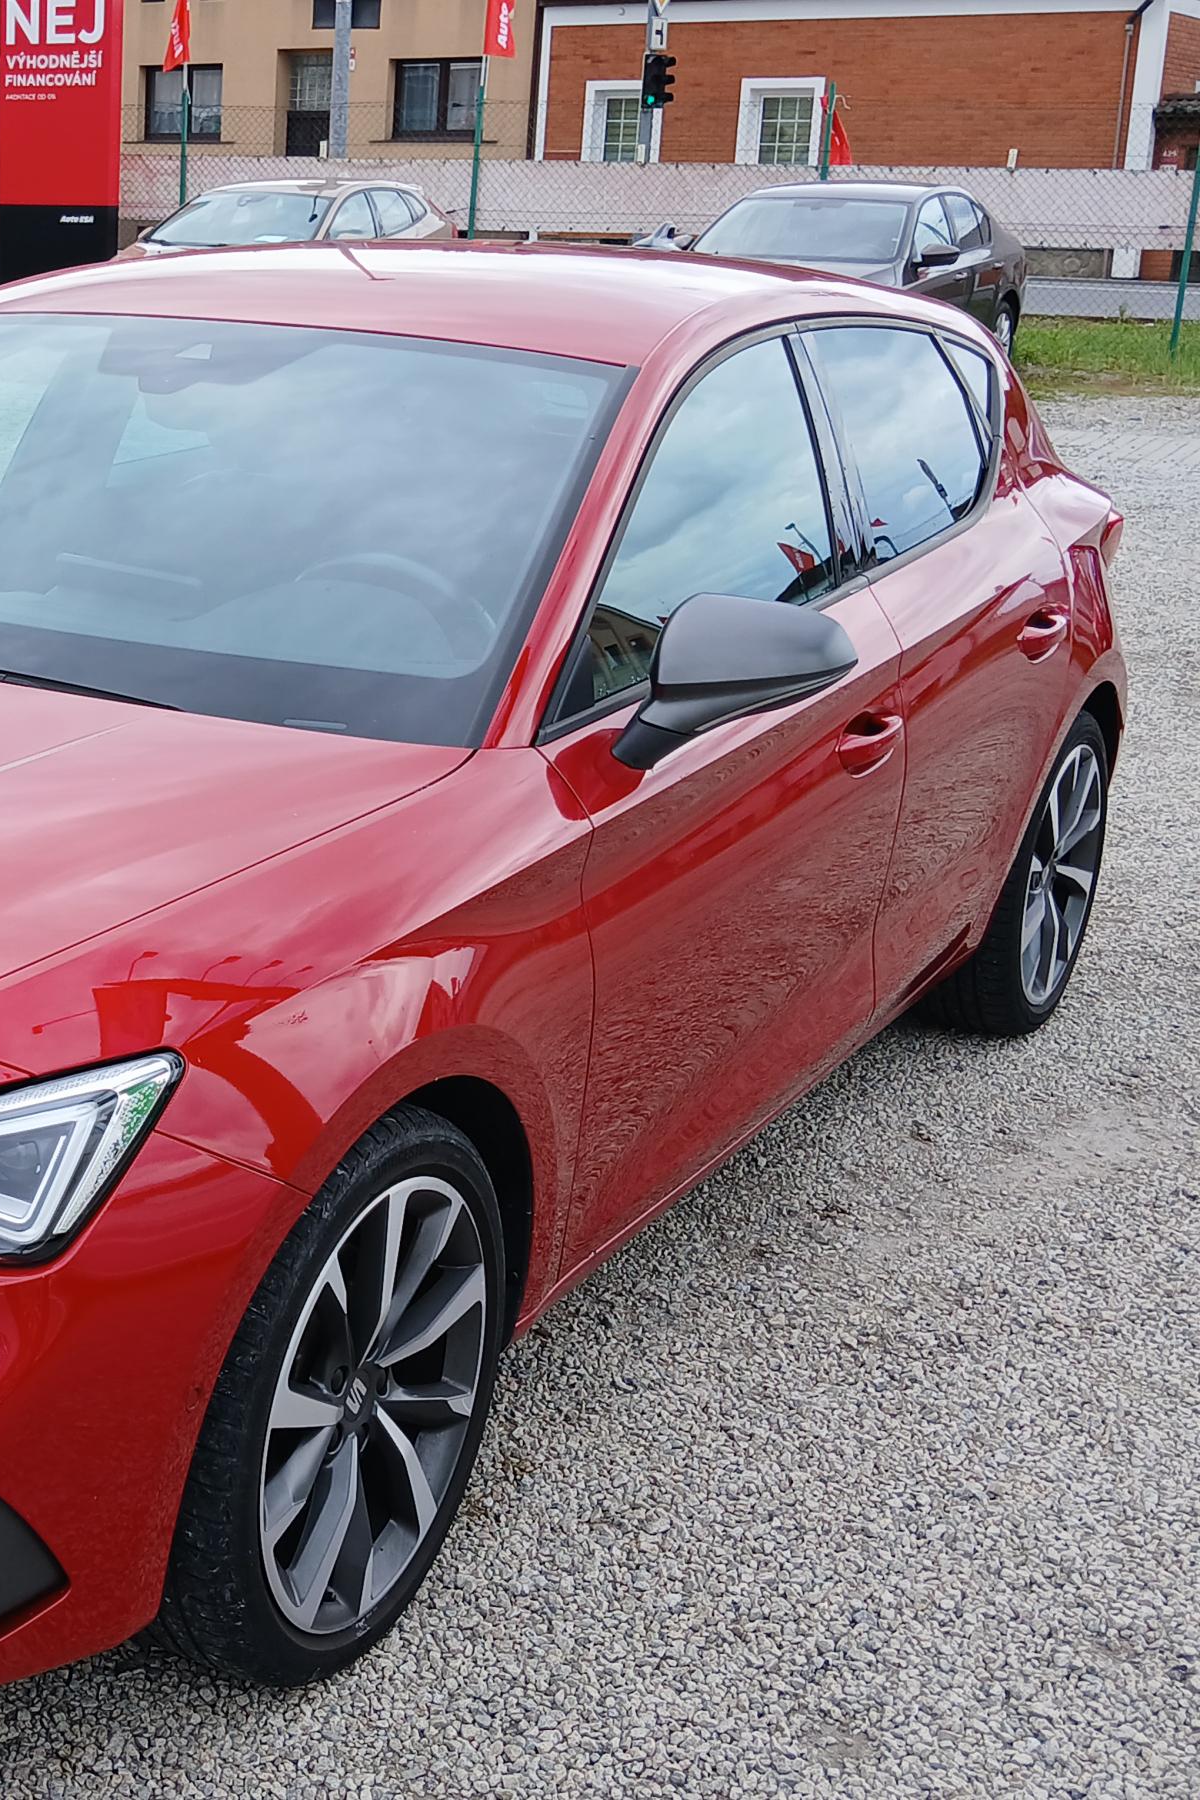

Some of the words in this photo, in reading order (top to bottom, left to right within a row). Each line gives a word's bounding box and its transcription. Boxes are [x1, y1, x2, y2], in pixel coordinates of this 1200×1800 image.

[6, 0, 104, 45] NEJ
[497, 2, 509, 49] Auto
[6, 50, 103, 70] VÝHODNĚJŠÍ
[5, 70, 97, 87] FINANCOVÁNÍ
[60, 215, 79, 223] Auto
